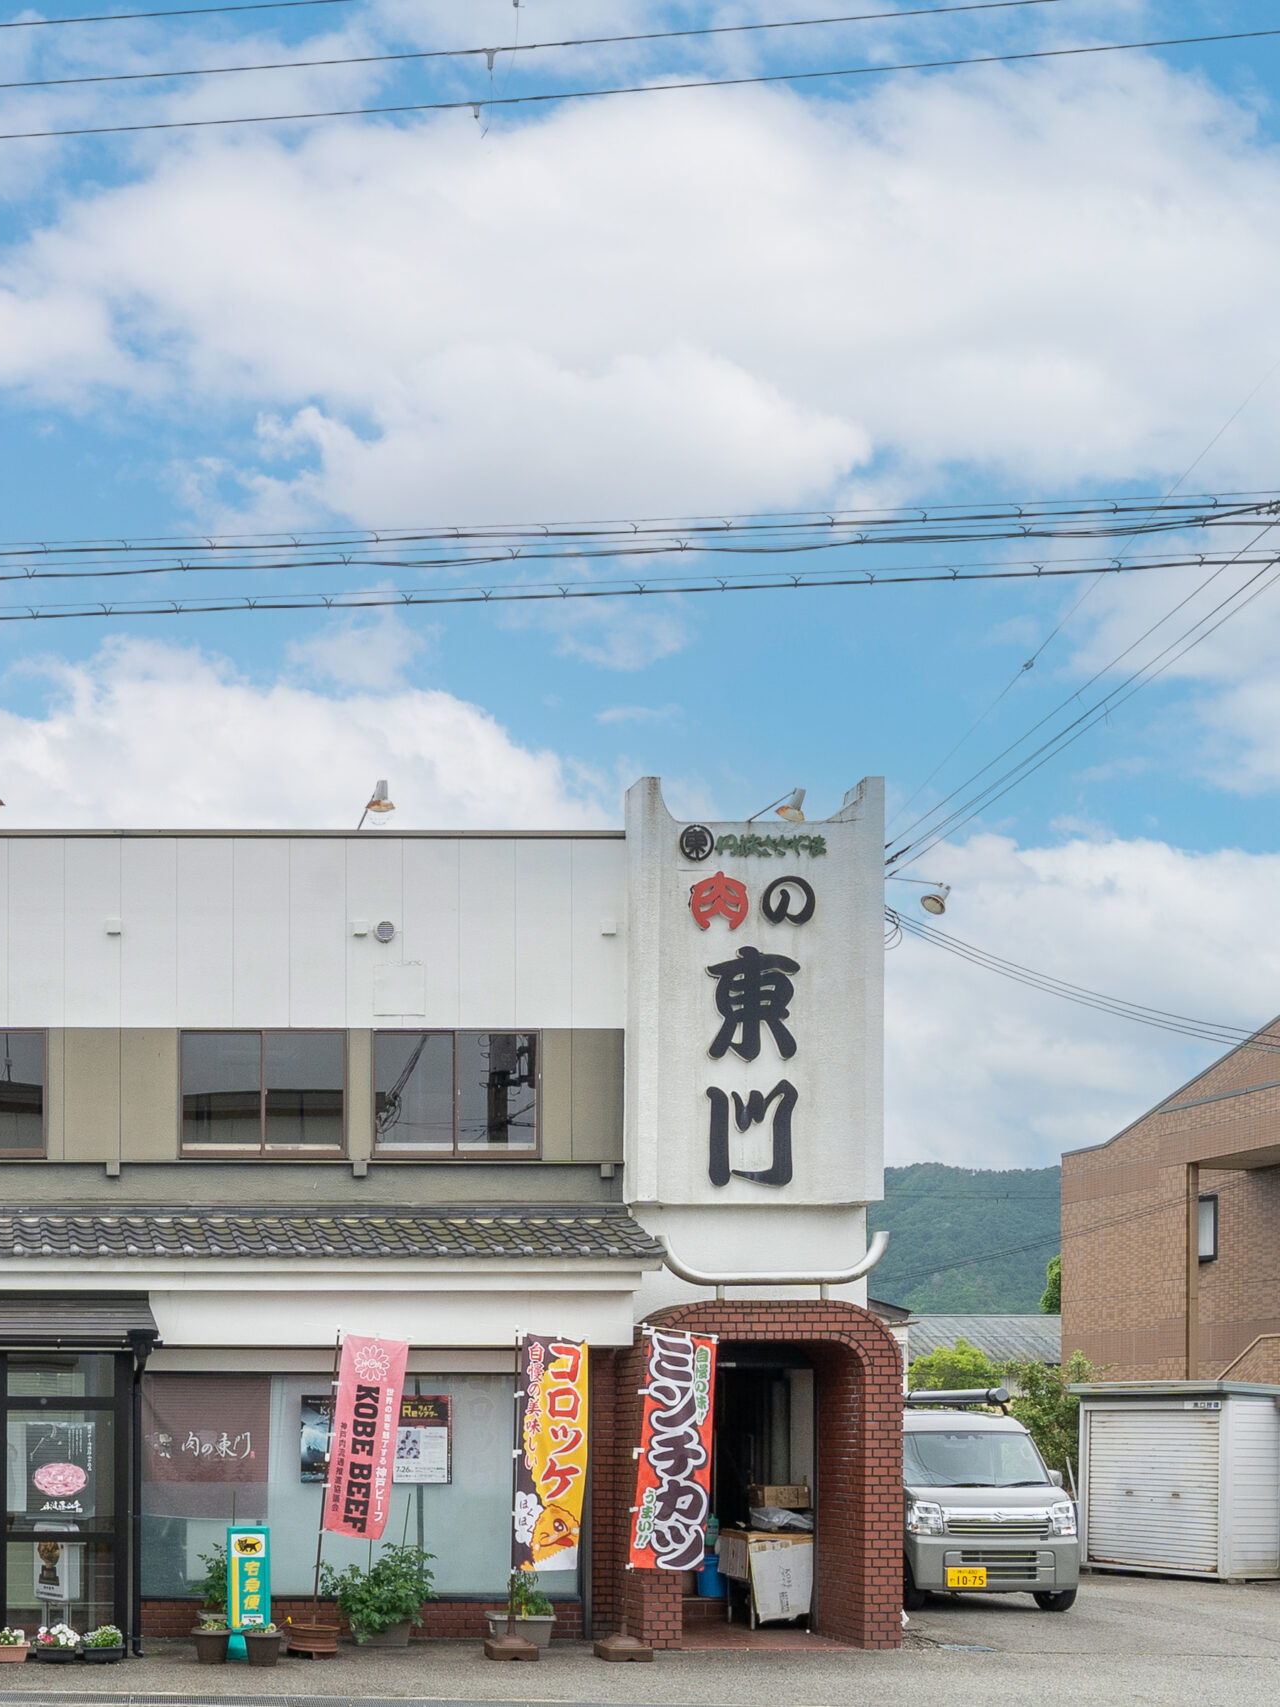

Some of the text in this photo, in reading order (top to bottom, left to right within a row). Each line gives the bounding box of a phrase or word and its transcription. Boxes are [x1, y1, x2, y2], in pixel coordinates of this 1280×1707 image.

[691, 871, 816, 931] 肉の
[351, 1384, 380, 1456] KOBE
[524, 1343, 545, 1470] 自慢の美味しい
[541, 1343, 583, 1500] コロッケ
[648, 1332, 708, 1570] ミンチカツ
[343, 1462, 372, 1533] BEEF
[243, 1561, 261, 1610] 宅急便
